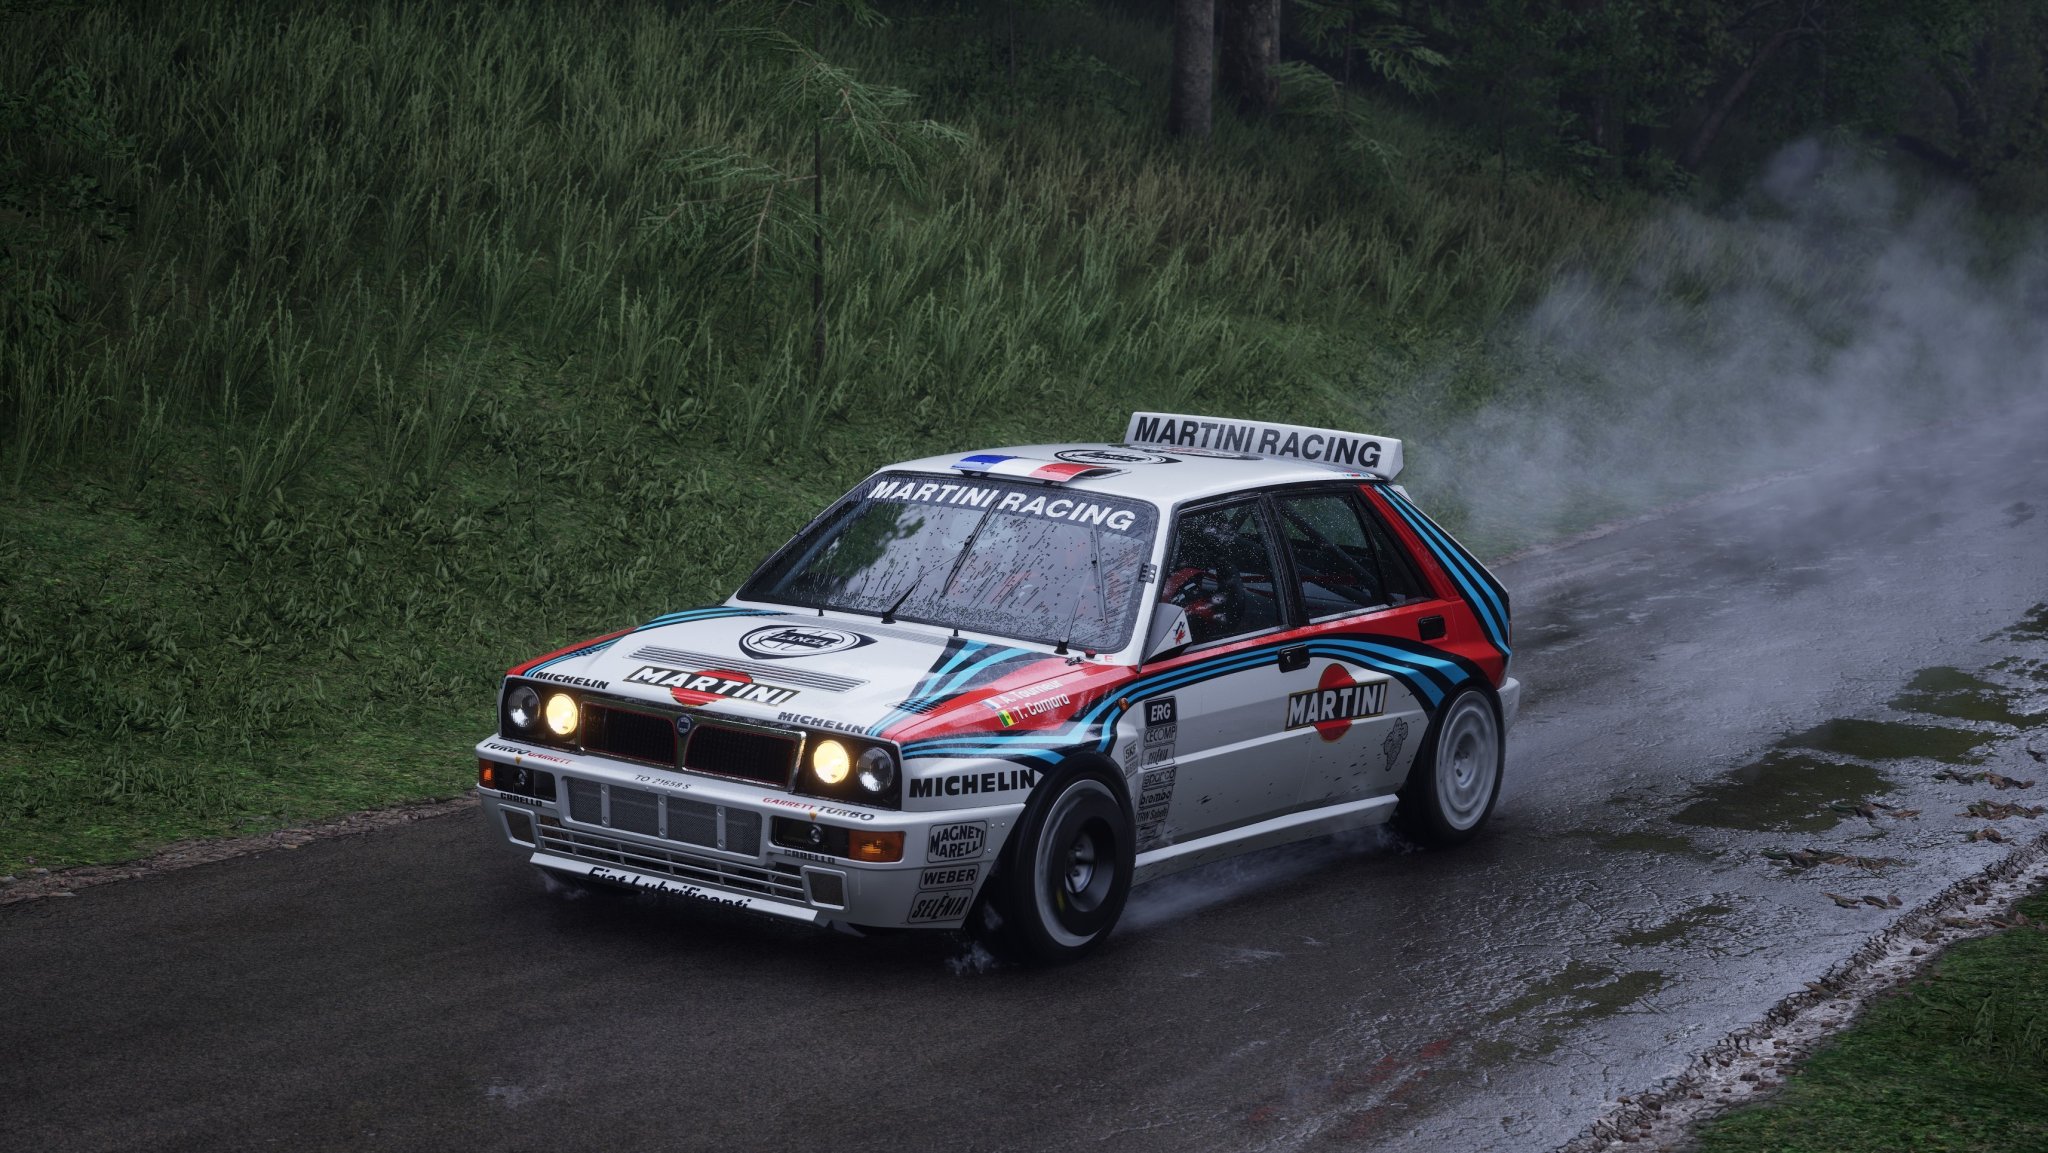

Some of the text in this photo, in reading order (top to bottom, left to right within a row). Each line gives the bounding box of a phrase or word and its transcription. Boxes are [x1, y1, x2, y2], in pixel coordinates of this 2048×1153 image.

[1134, 416, 1382, 468] MARTINI RACING
[867, 481, 1136, 531] MARTINI RACING
[534, 671, 610, 690] MICHELIN
[629, 666, 794, 705] MARTINI
[1012, 693, 1071, 719] T. Camara
[1150, 703, 1171, 722] ERG
[1287, 683, 1387, 728] MARTINI
[778, 711, 866, 734] MICHELIN
[1145, 724, 1176, 743] CECOMP
[634, 774, 651, 782] TO
[909, 769, 1035, 798] MICHELIN
[1143, 768, 1175, 785] sparco
[1140, 788, 1171, 805] brembo
[762, 797, 875, 822] GARRETT TURBO
[930, 825, 985, 846] MAGNETI
[930, 836, 985, 858] MARELLI
[923, 868, 976, 885] WEBER
